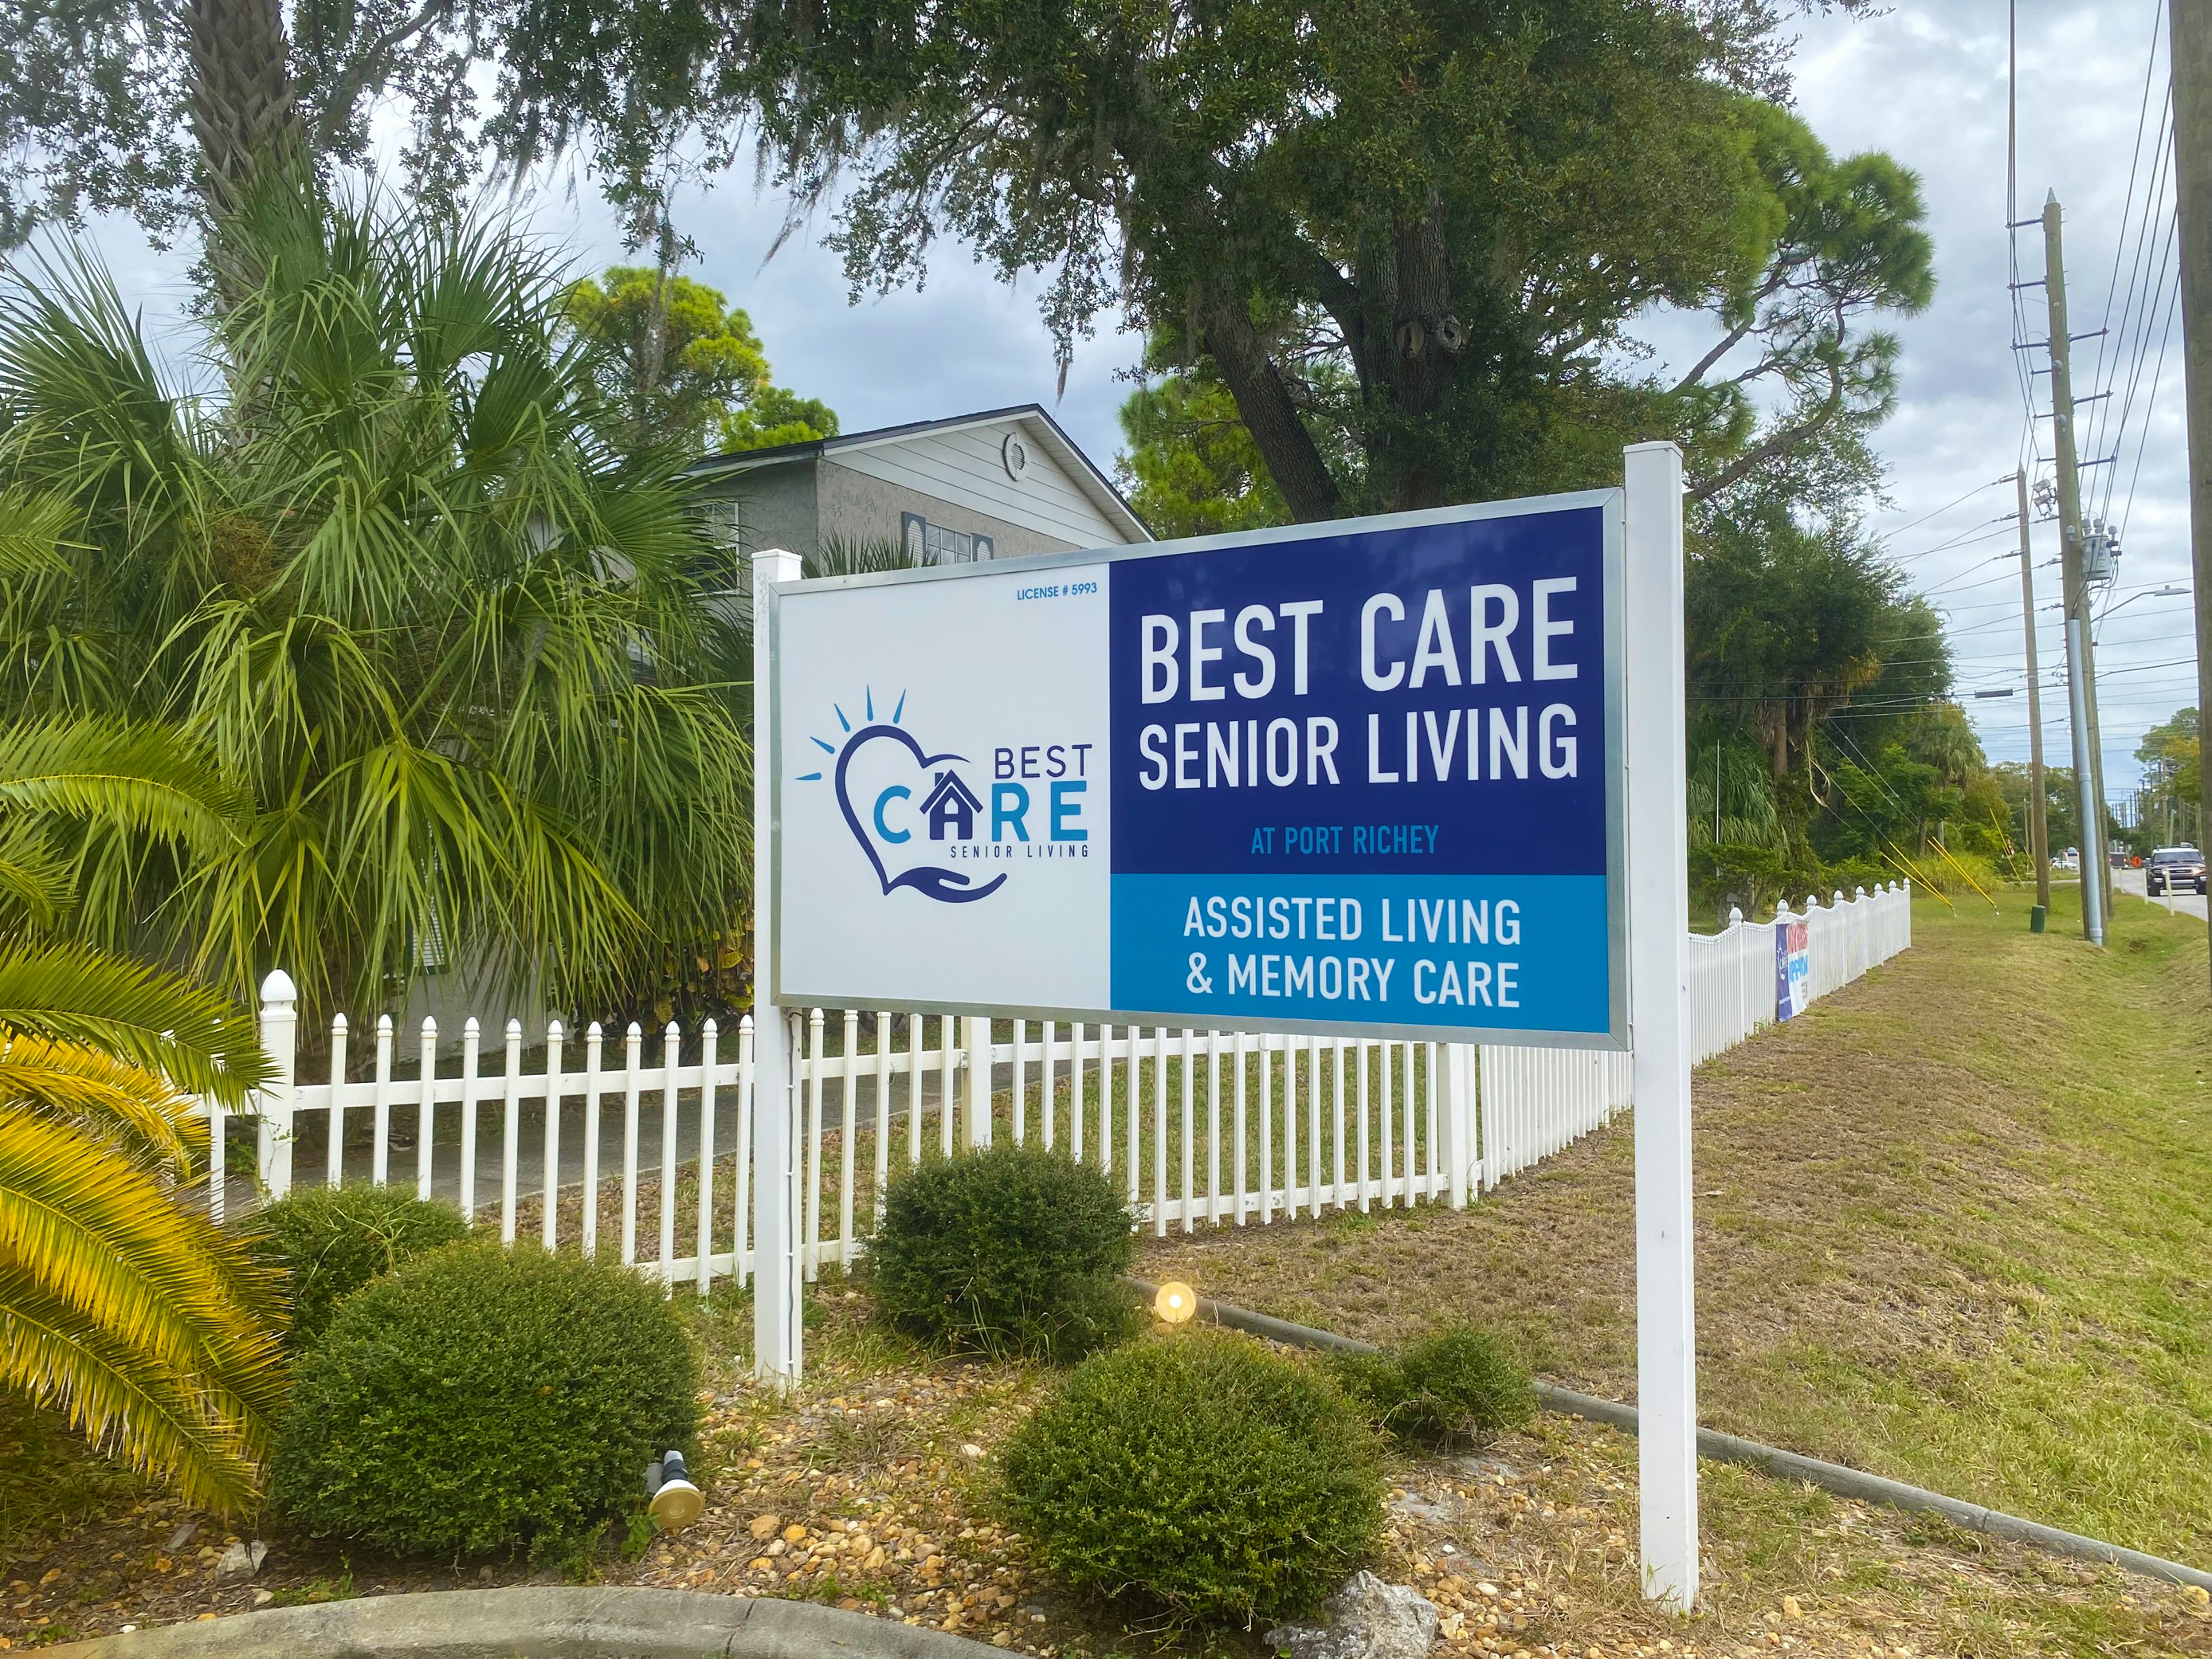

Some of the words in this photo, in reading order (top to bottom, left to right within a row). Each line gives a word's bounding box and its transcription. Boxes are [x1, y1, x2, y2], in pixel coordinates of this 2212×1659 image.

[1017, 586, 1059, 600] LICENSE
[1062, 585, 1069, 596] #
[1072, 582, 1097, 595] 5993
[1141, 599, 1324, 704] BEST
[1360, 576, 1579, 692] CARE
[994, 744, 1092, 779] BEST
[1139, 716, 1340, 790] SENIOR
[1368, 703, 1579, 784] LIVING
[873, 776, 1088, 844] CARE
[951, 845, 1014, 859] SENIOR
[1027, 844, 1088, 858] LIVING
[1250, 826, 1275, 854] AT
[1285, 826, 1343, 854] PORT
[1353, 824, 1439, 854] RICHEY
[1183, 896, 1362, 941] ASSISTED
[1382, 897, 1521, 946] LIVING
[1186, 951, 1213, 994] &
[1228, 953, 1395, 1002] MEMORY
[1414, 958, 1520, 1009] CARE
